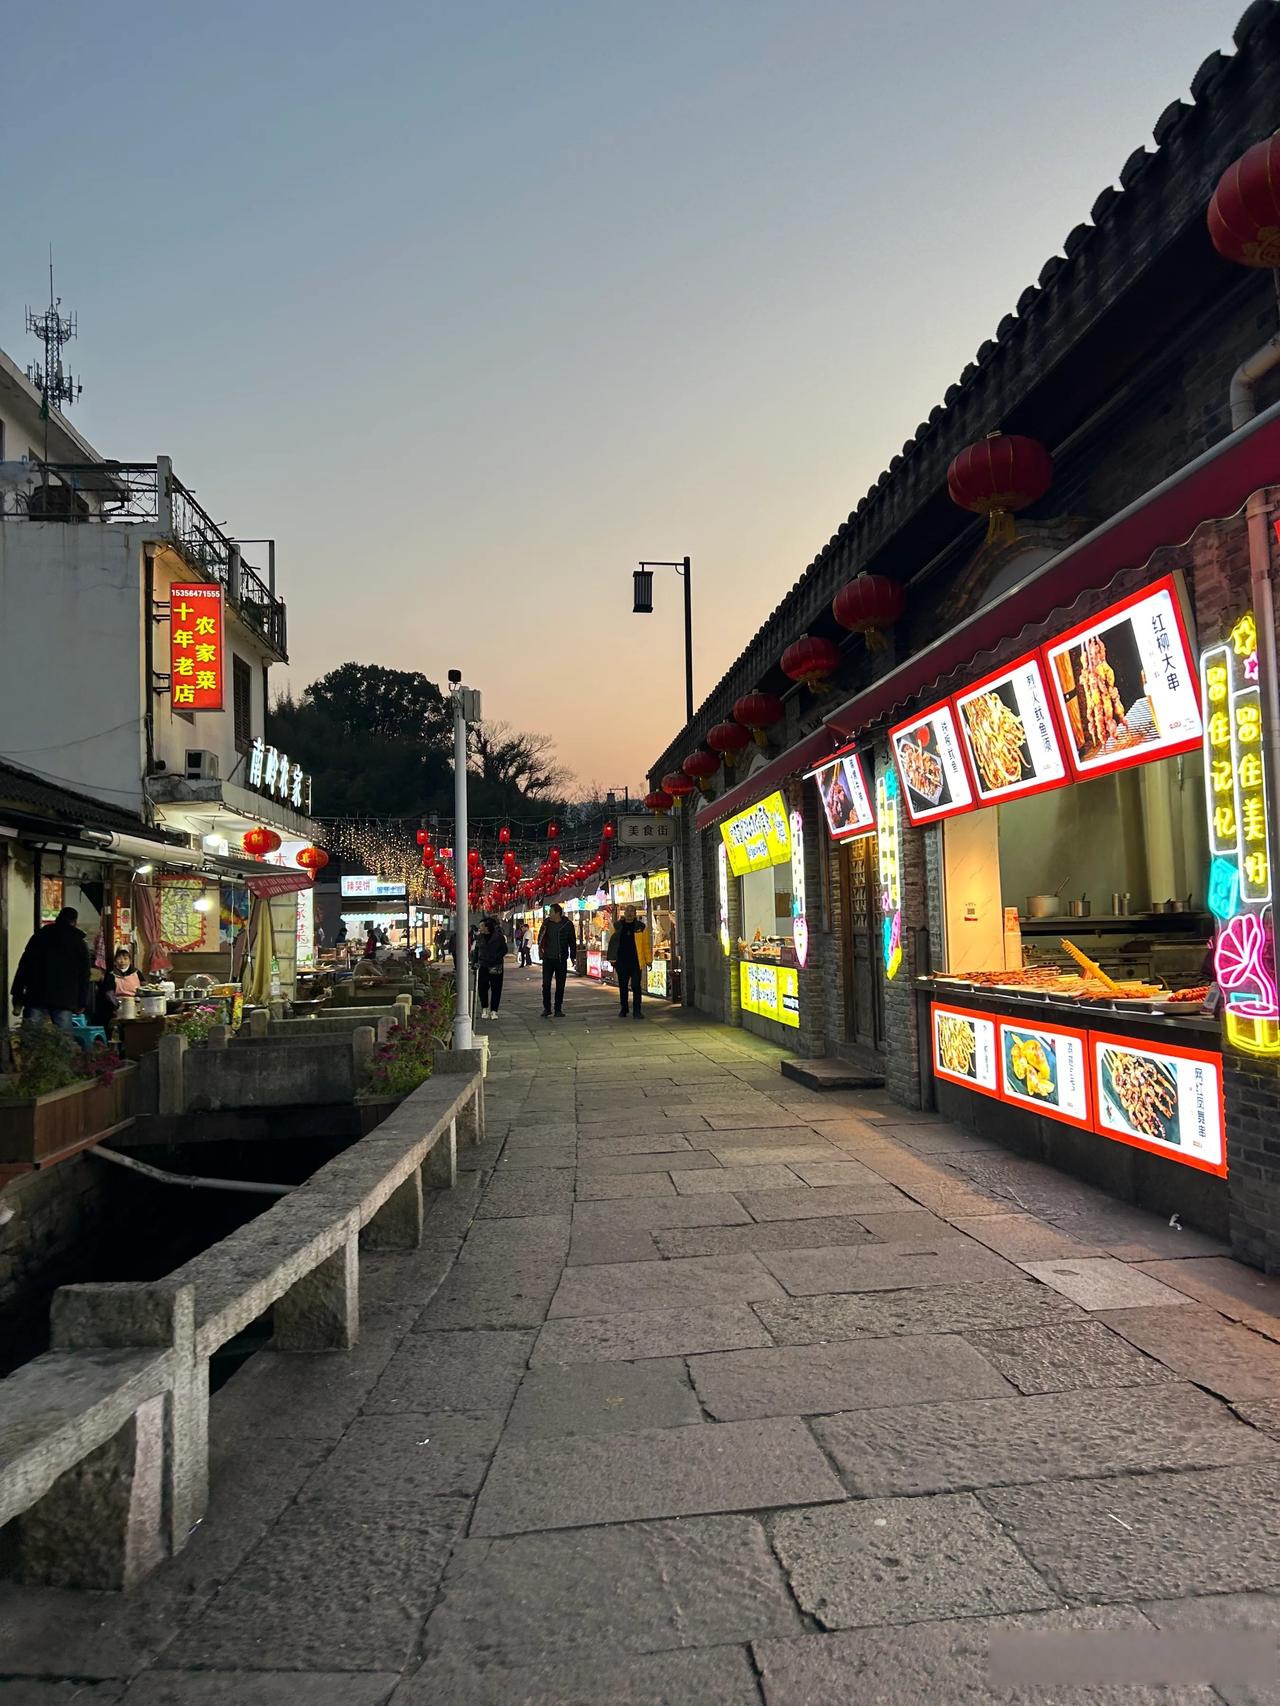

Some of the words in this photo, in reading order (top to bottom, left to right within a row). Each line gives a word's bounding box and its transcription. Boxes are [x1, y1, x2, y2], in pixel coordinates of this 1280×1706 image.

[171, 589, 220, 598] 15356471555
[173, 602, 195, 703] 十年老店
[194, 616, 216, 690] 农家菜
[1151, 613, 1180, 692] 红柳大串
[1206, 666, 1236, 837] 留住记忆
[628, 824, 669, 837] 美食街
[1235, 706, 1268, 884] 留住美好
